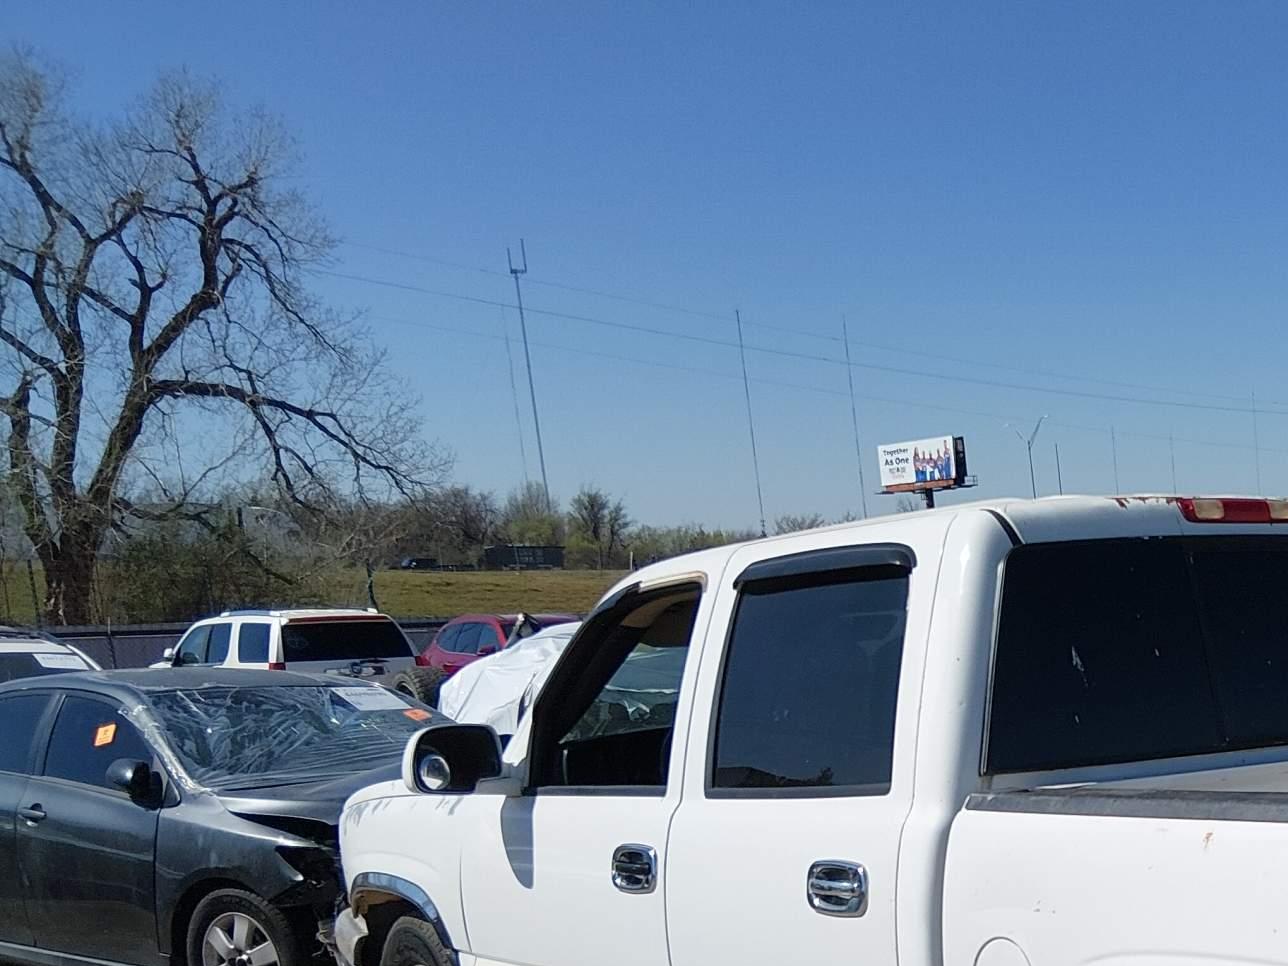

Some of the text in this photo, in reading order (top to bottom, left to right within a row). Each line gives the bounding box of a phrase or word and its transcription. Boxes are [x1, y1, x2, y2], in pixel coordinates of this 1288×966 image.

[883, 447, 909, 457] Together
[884, 457, 910, 466] As One
